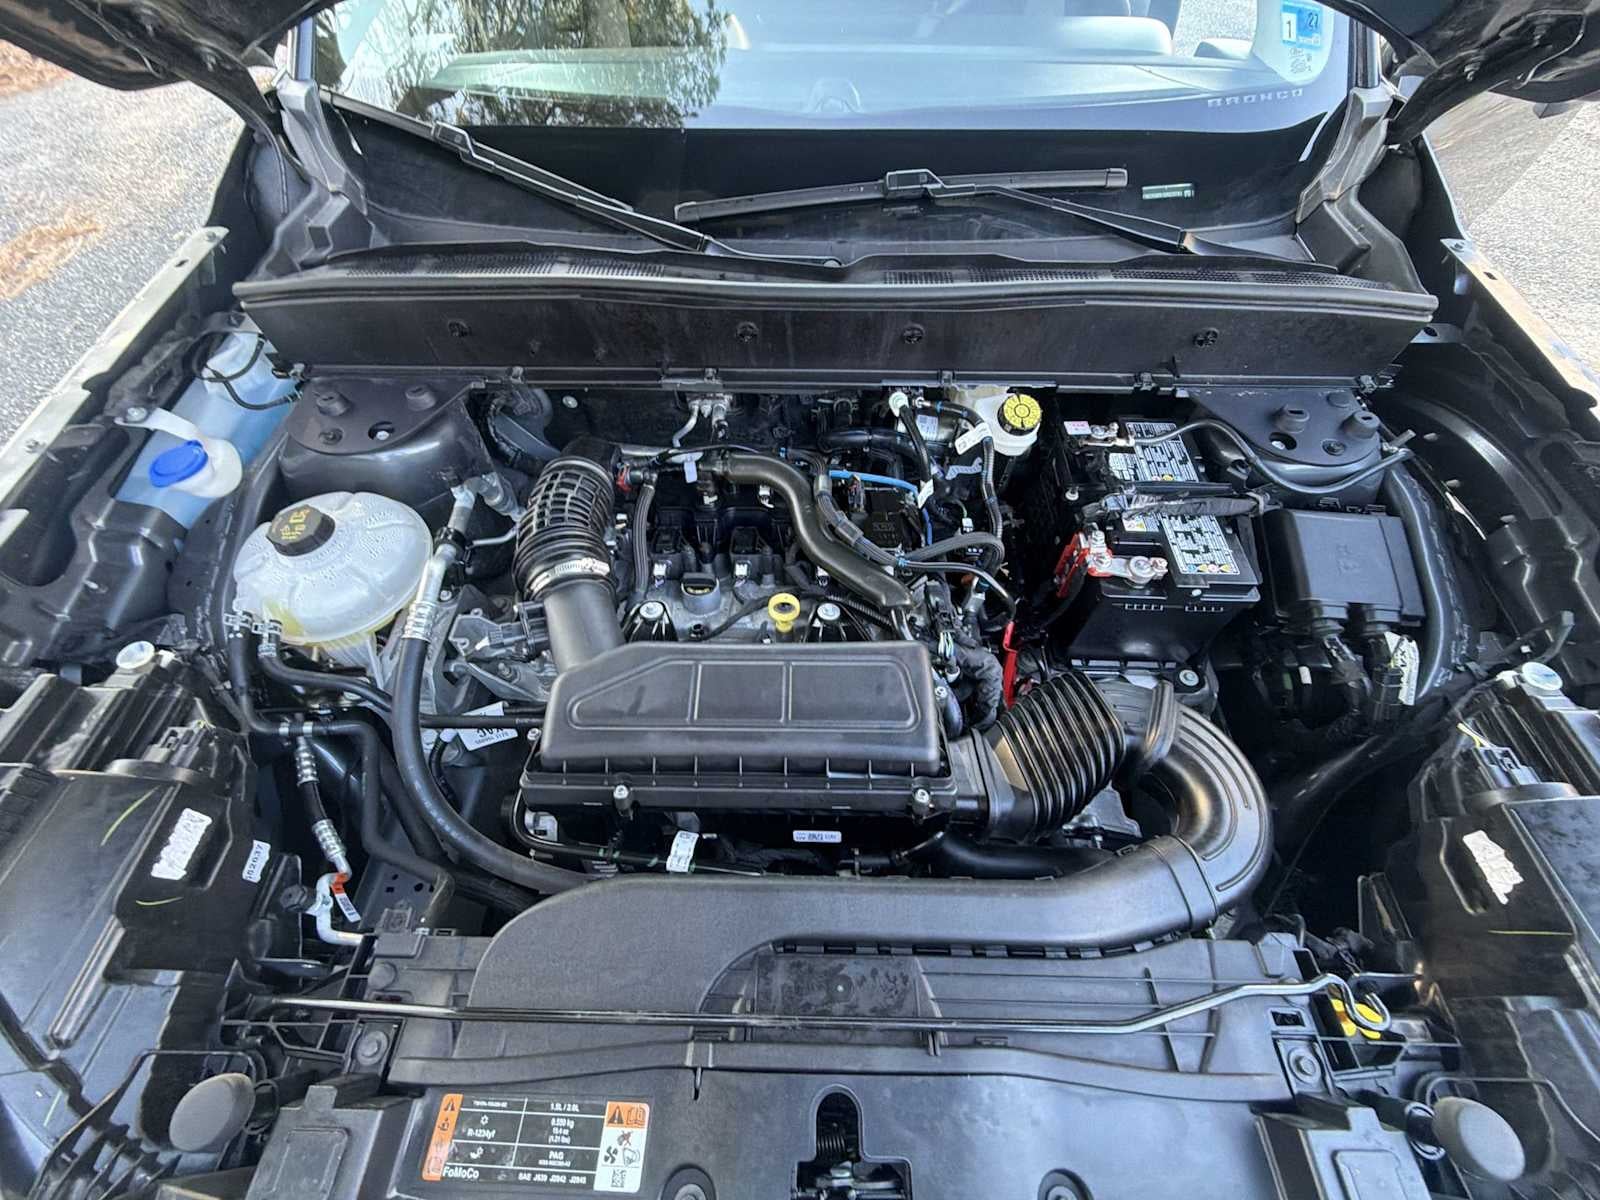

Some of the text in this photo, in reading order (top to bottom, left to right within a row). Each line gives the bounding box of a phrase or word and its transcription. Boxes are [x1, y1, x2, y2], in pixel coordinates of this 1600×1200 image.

[1207, 88, 1304, 108] BRONCO
[549, 1151, 564, 1160] PAG
[442, 1166, 480, 1179] FoMoCo
